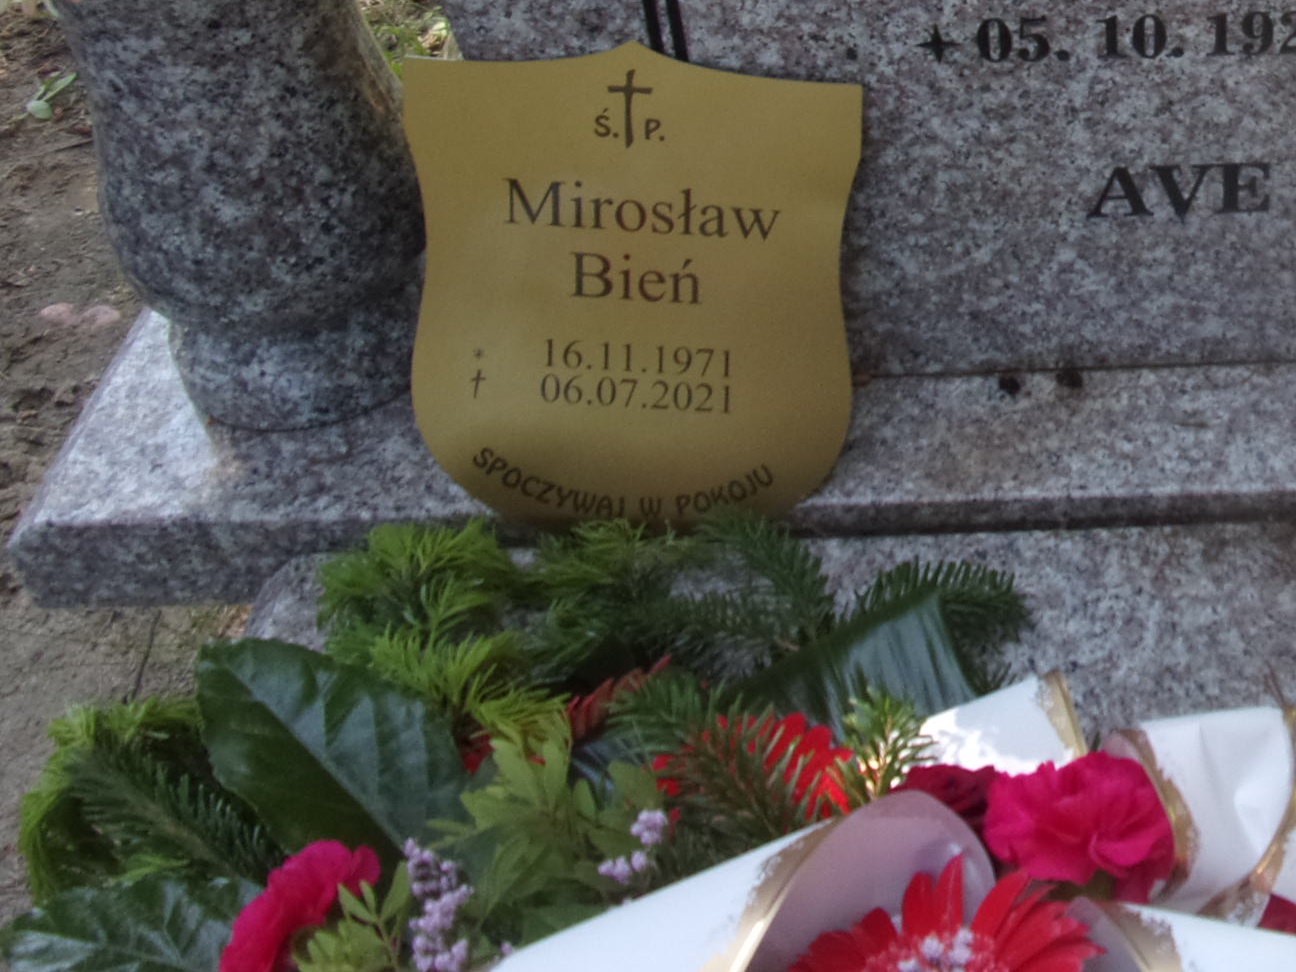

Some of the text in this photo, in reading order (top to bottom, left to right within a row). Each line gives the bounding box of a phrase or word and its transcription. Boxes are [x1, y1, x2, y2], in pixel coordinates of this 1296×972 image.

[977, 15, 1071, 63] 05.
[1098, 13, 1184, 60] 10.
[501, 177, 782, 242] Mirosław
[1087, 161, 1271, 222] AVE
[571, 251, 702, 305] Bień
[543, 338, 732, 378] 16.11.1971
[540, 373, 732, 414] 06.07.2021
[472, 446, 775, 519] SPOCZYWAJ W POKOJU
